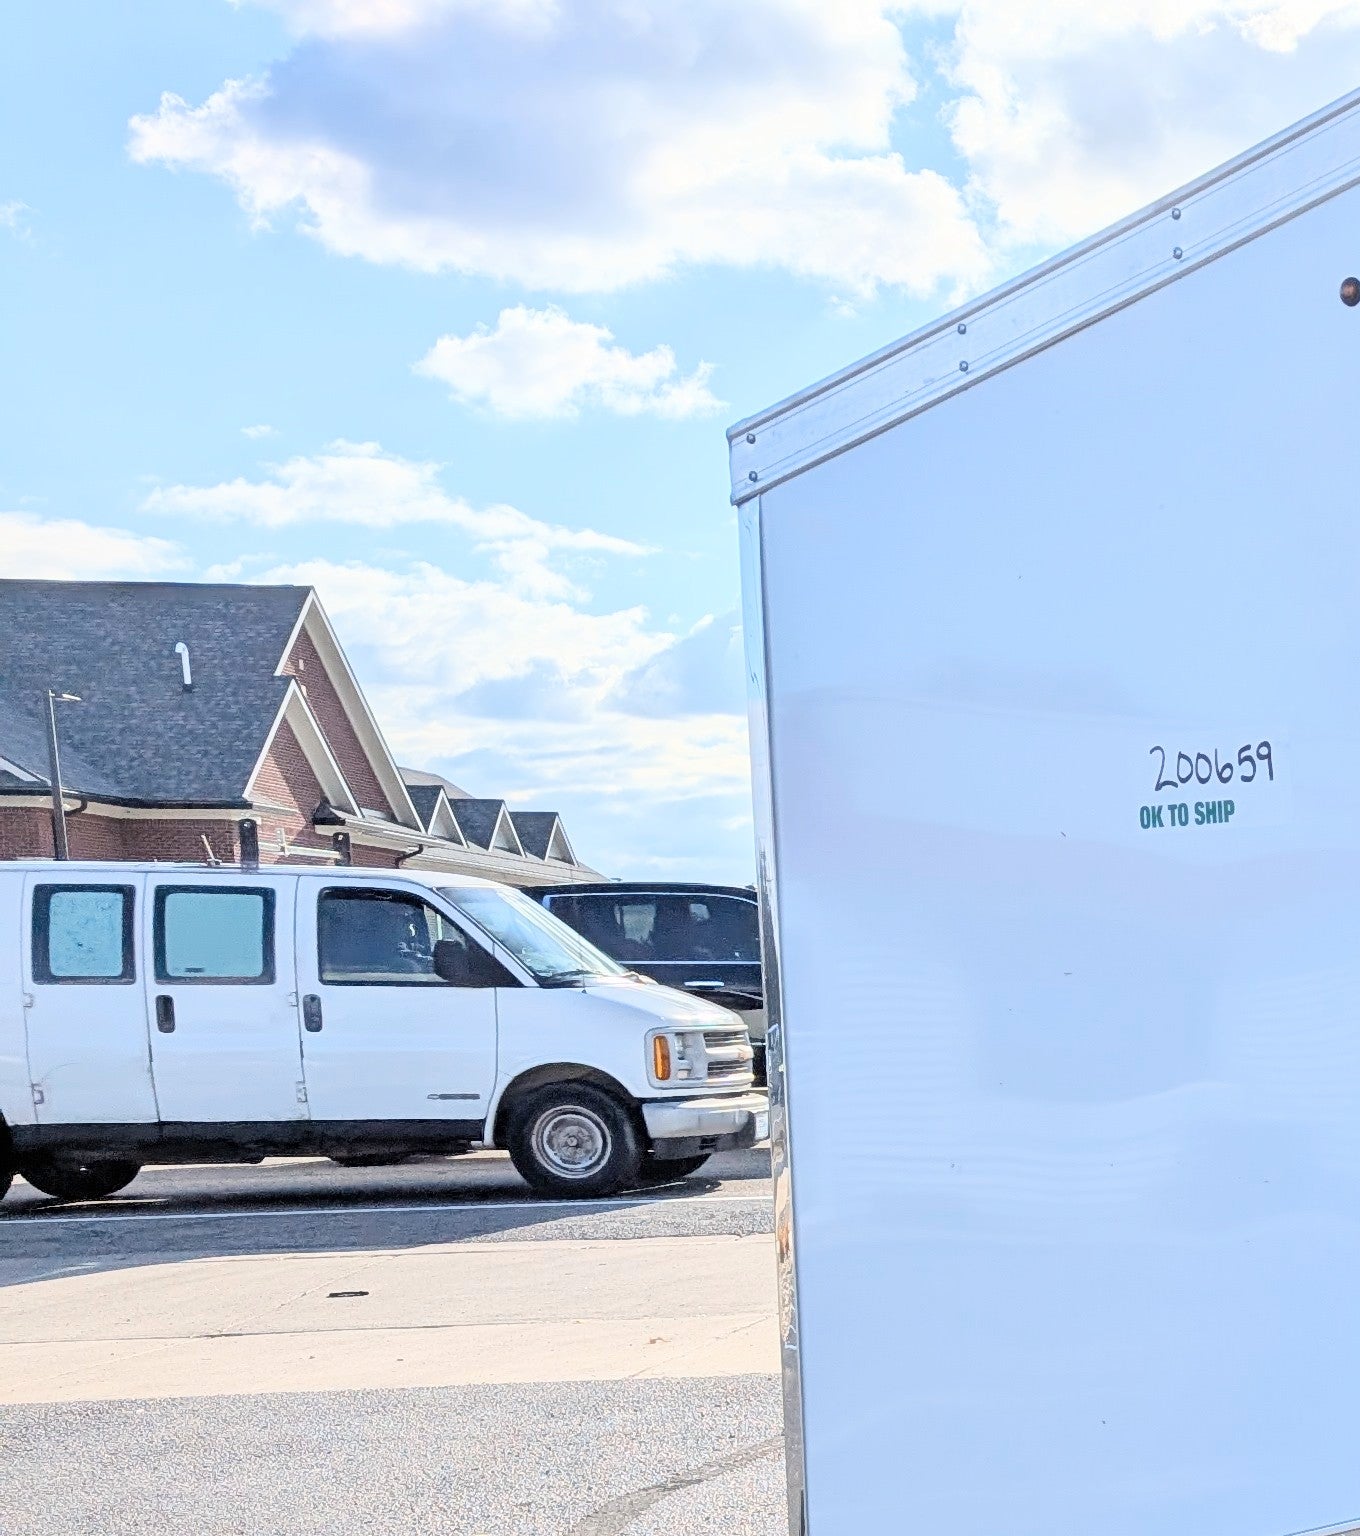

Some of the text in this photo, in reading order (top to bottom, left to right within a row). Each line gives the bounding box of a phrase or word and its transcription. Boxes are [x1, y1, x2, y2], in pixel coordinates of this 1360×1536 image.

[1149, 740, 1274, 792] 200659
[1139, 799, 1236, 830] OK TO SHIP
